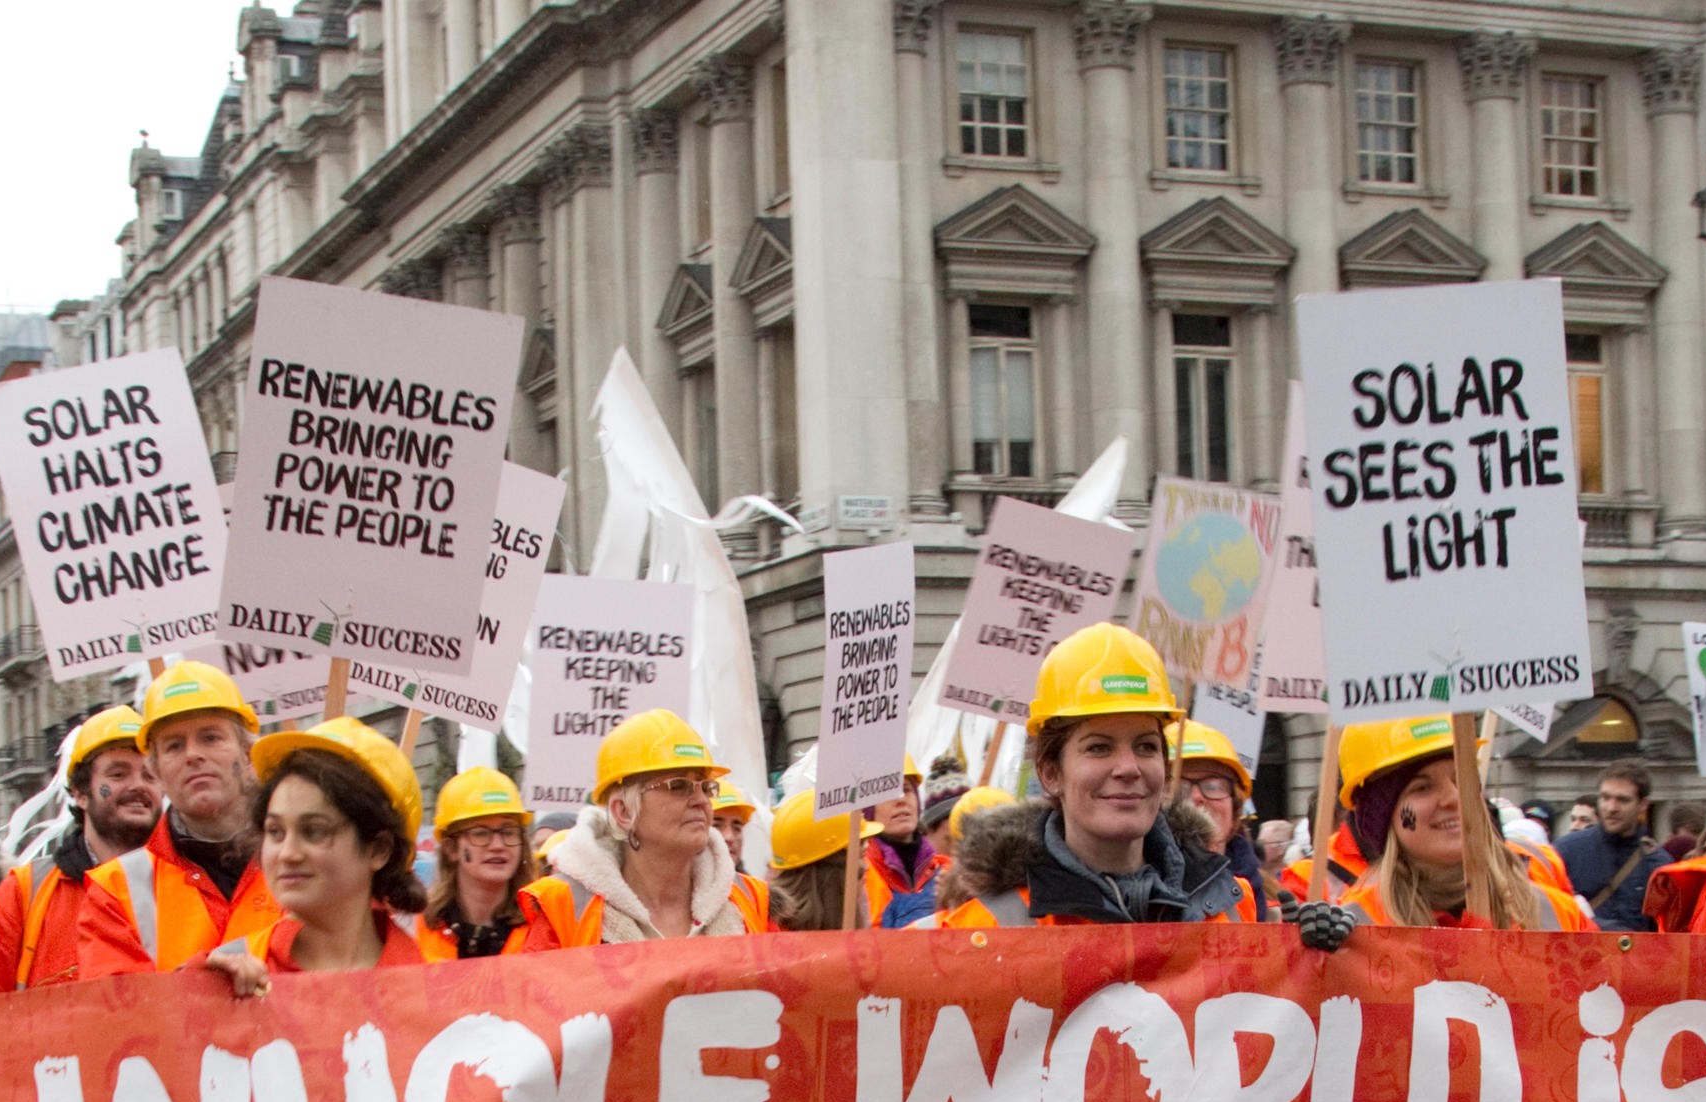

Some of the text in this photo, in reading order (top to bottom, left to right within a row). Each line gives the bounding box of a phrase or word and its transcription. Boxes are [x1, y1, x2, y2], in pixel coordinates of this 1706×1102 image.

[24, 385, 160, 446] SOLAR
[258, 358, 496, 431] RENEWABLES
[1351, 356, 1529, 429] SOLAR
[43, 437, 162, 495] HALTS
[288, 409, 453, 469] BRINGING
[274, 453, 455, 512] POWER TO
[1323, 439, 1457, 509] SEES
[1468, 427, 1565, 494] THE
[38, 483, 200, 552] CLIMATE
[263, 494, 329, 536] THE
[334, 504, 457, 558] PEOPLE
[54, 534, 210, 604] CHANGE
[985, 543, 1115, 596] RENEWABLES
[58, 611, 219, 667] DAILY SUCCE
[229, 603, 461, 661] DAILY SUCCESS
[538, 625, 685, 658] RENEWABLES
[830, 601, 910, 640] RENEWABLES
[1018, 606, 1055, 633] THE
[841, 634, 898, 670] BRINGING
[349, 662, 498, 722] DAILY SUCCESS
[591, 686, 629, 710] THE
[836, 663, 898, 702] POWER TO
[1267, 676, 1323, 700] DAILY
[1342, 654, 1580, 709] DAILY SUCCESS
[832, 693, 899, 735] THE PEOPLE
[532, 786, 585, 803] DAILY
[818, 772, 901, 809] DAILY SUCCESS
